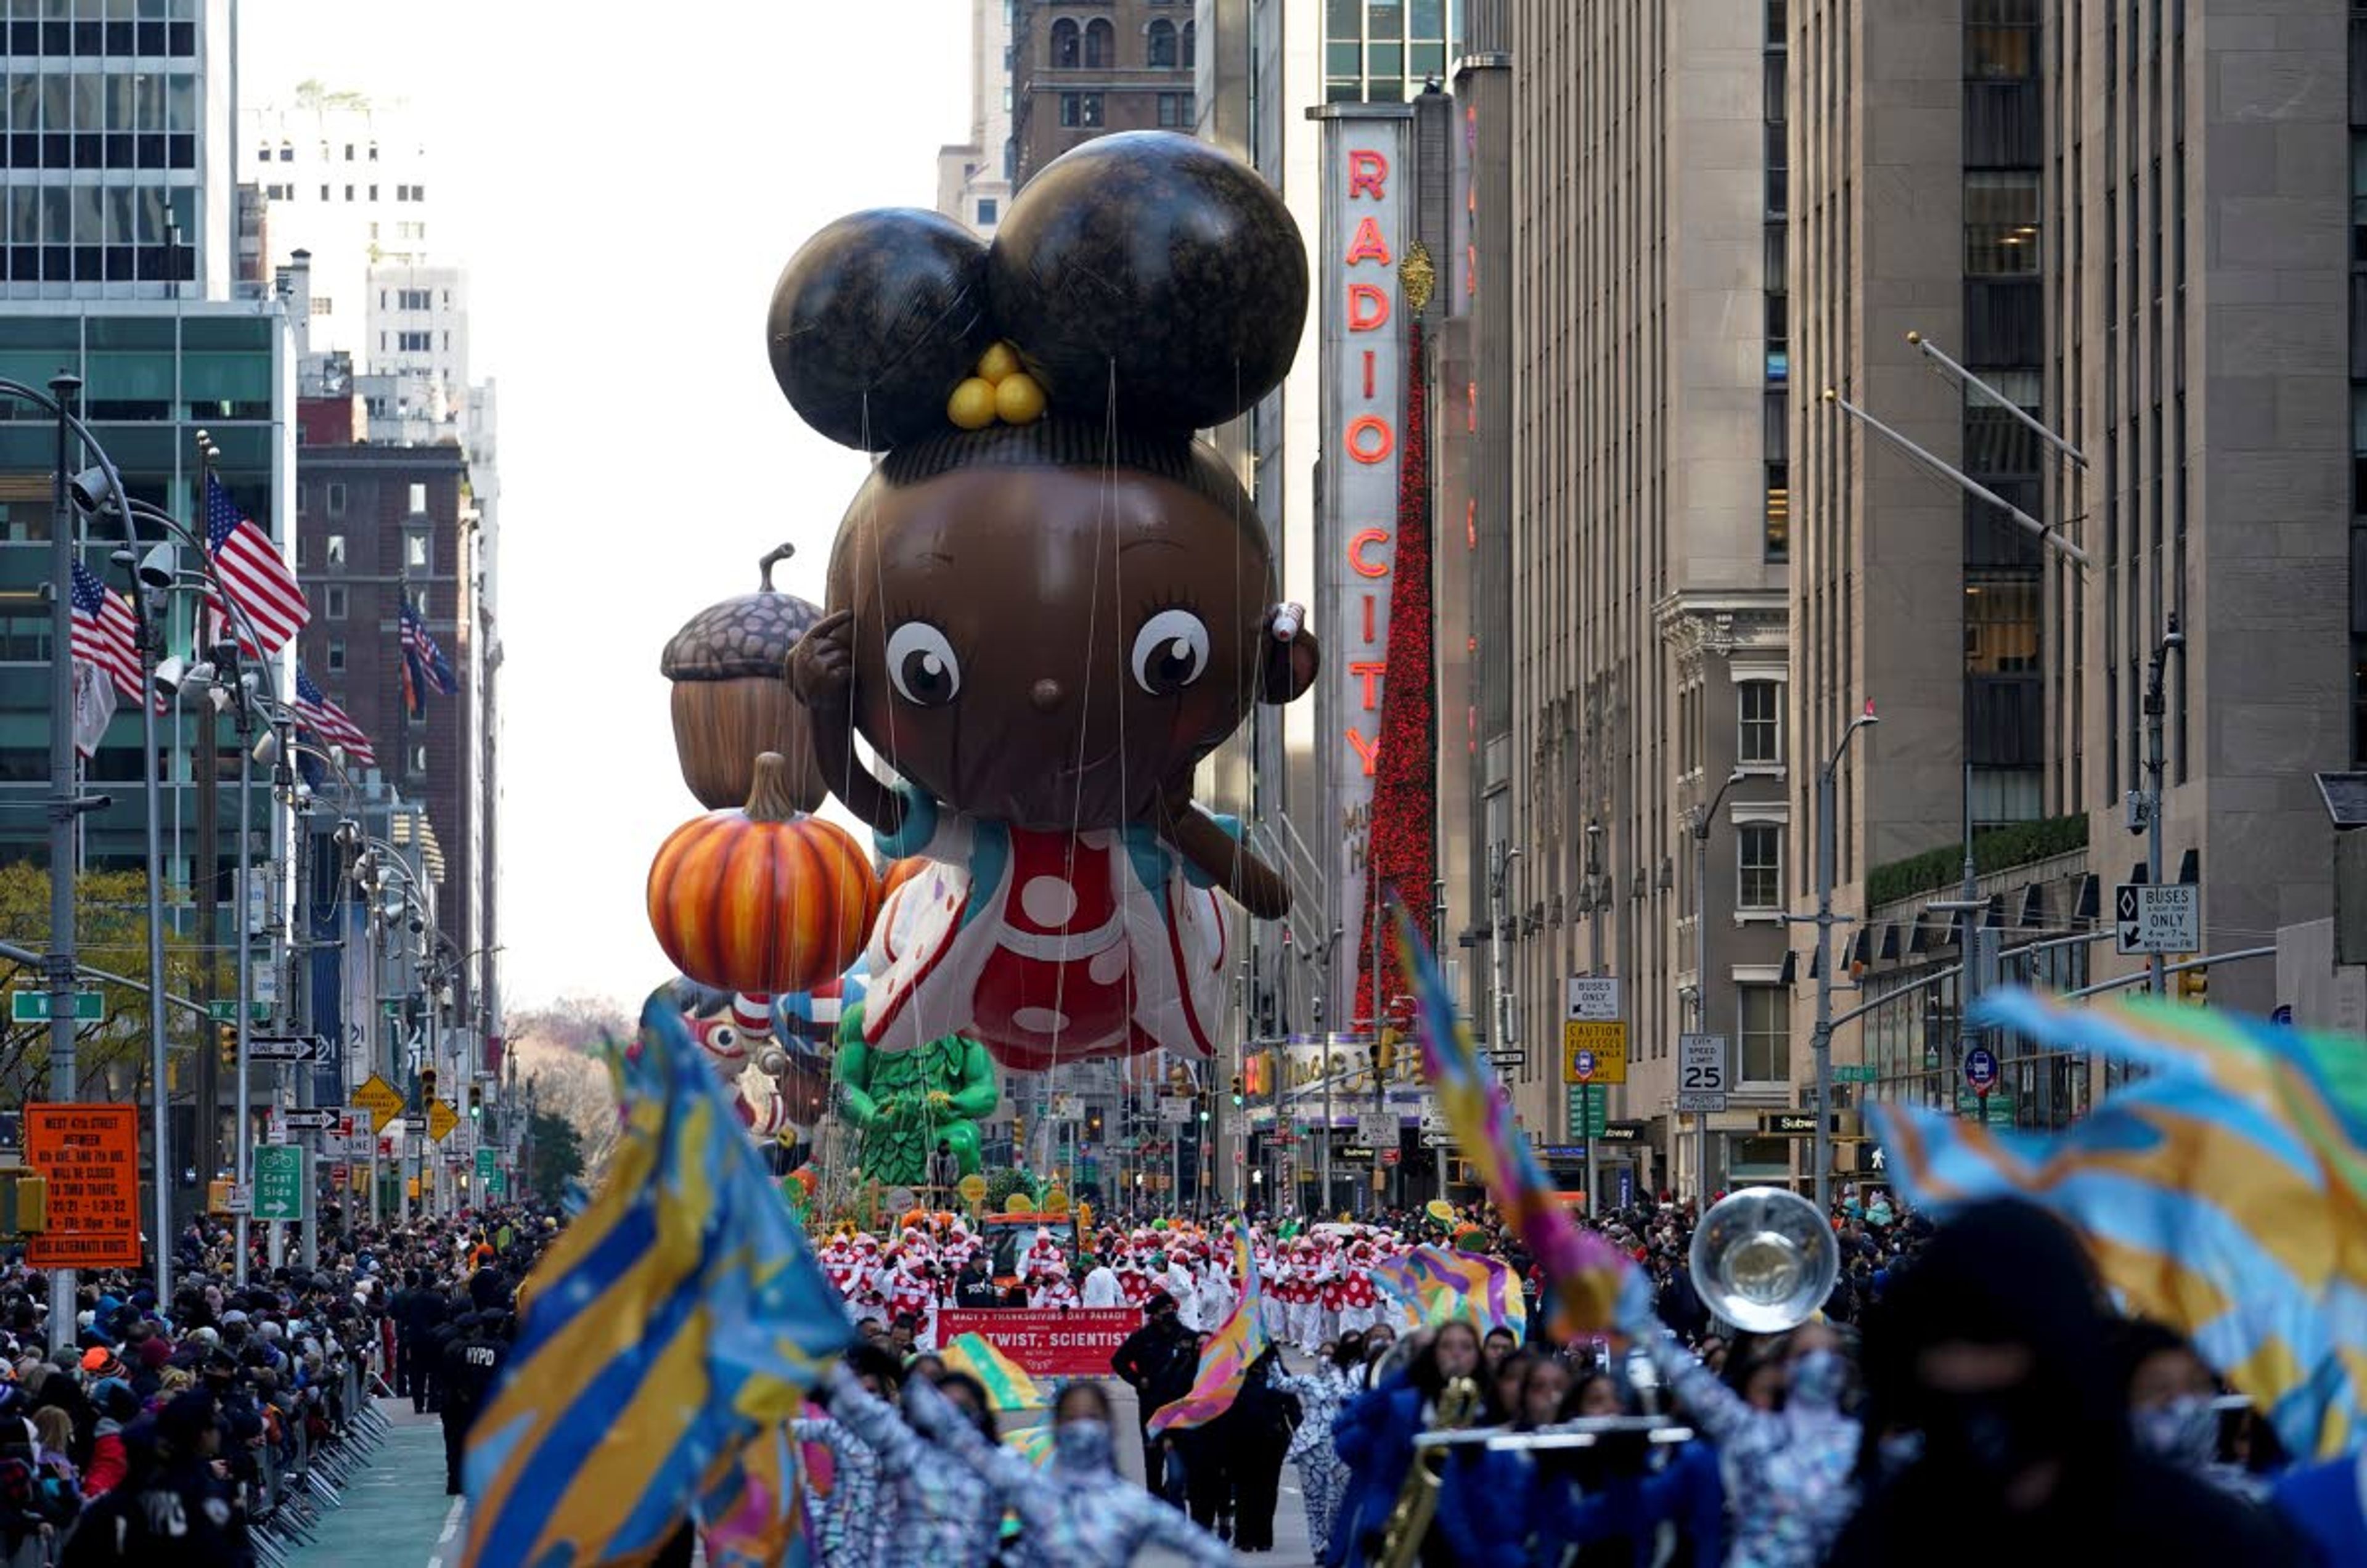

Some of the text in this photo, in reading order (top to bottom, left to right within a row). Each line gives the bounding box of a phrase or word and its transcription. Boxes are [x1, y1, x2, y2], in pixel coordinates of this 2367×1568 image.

[1344, 150, 1394, 463] RADIO
[1346, 528, 1390, 777] CITY
[2146, 889, 2189, 904] BUSES
[2150, 913, 2185, 928] ONLY
[1578, 981, 1611, 991] BUSES
[1582, 992, 1607, 1001] ONLY
[38, 997, 49, 1015] W
[210, 1005, 223, 1017] W
[1569, 1025, 1621, 1037] CAUTION
[1684, 1066, 1721, 1088] 25
[311, 1116, 330, 1124] WAY
[1781, 1117, 1818, 1129] Subwa
[1605, 1129, 1634, 1138] bway
[263, 1173, 292, 1183] East
[263, 1187, 292, 1196] Side
[1067, 1312, 1085, 1320] DAY
[1090, 1311, 1127, 1320] PARADE
[465, 1346, 495, 1366] NYPD
